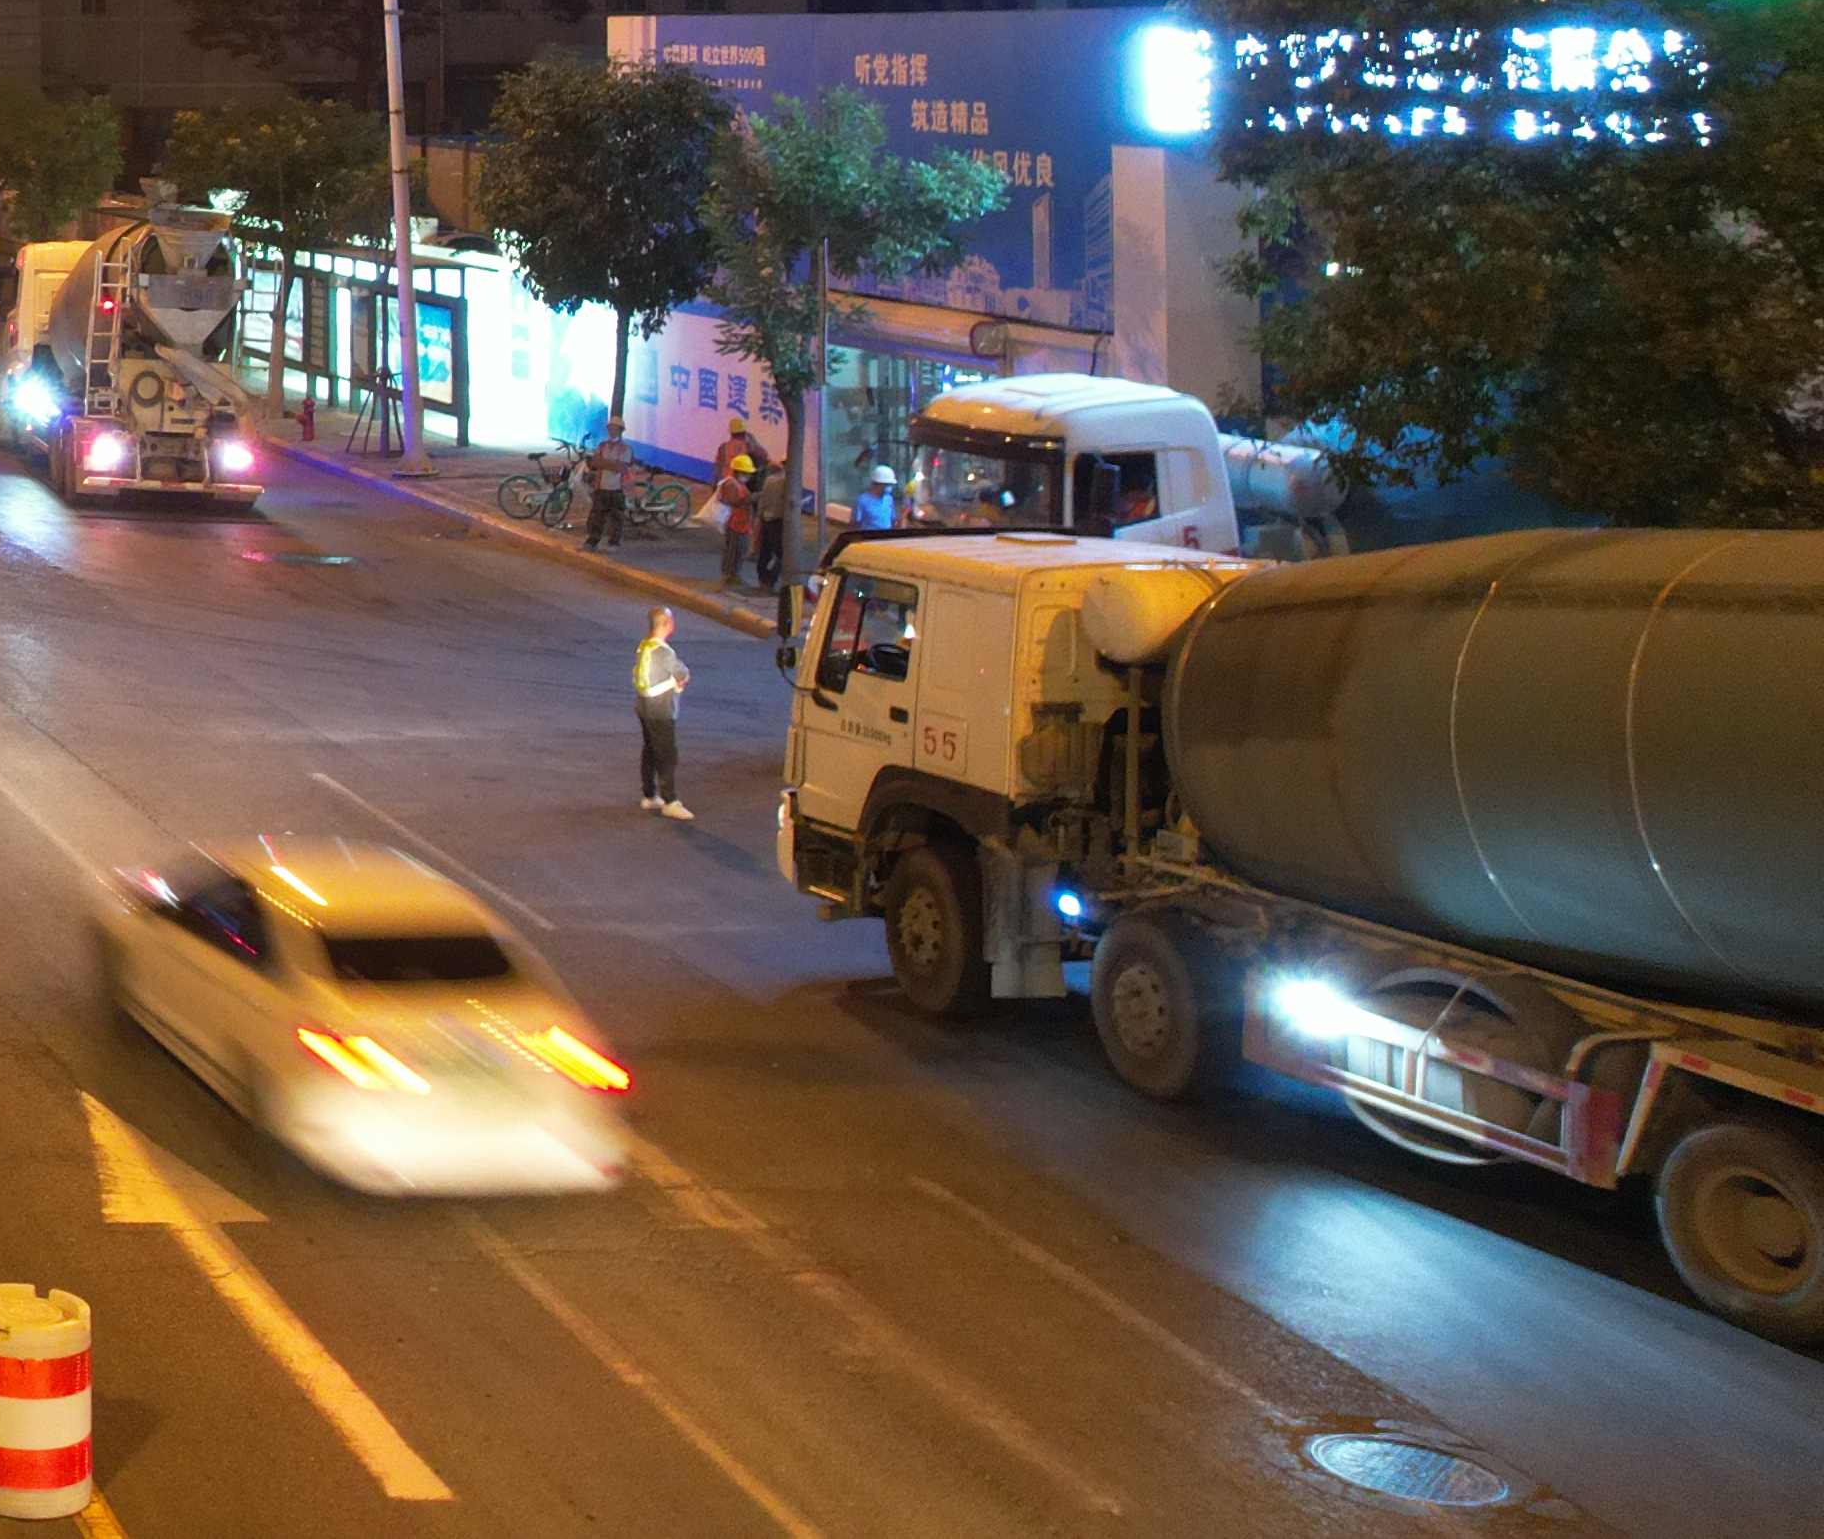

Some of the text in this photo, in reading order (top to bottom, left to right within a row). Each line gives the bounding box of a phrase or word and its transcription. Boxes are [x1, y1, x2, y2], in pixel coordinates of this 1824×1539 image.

[854, 52, 928, 88] 听党指挥
[910, 98, 989, 137] 筑造精品
[923, 725, 958, 762] 55
